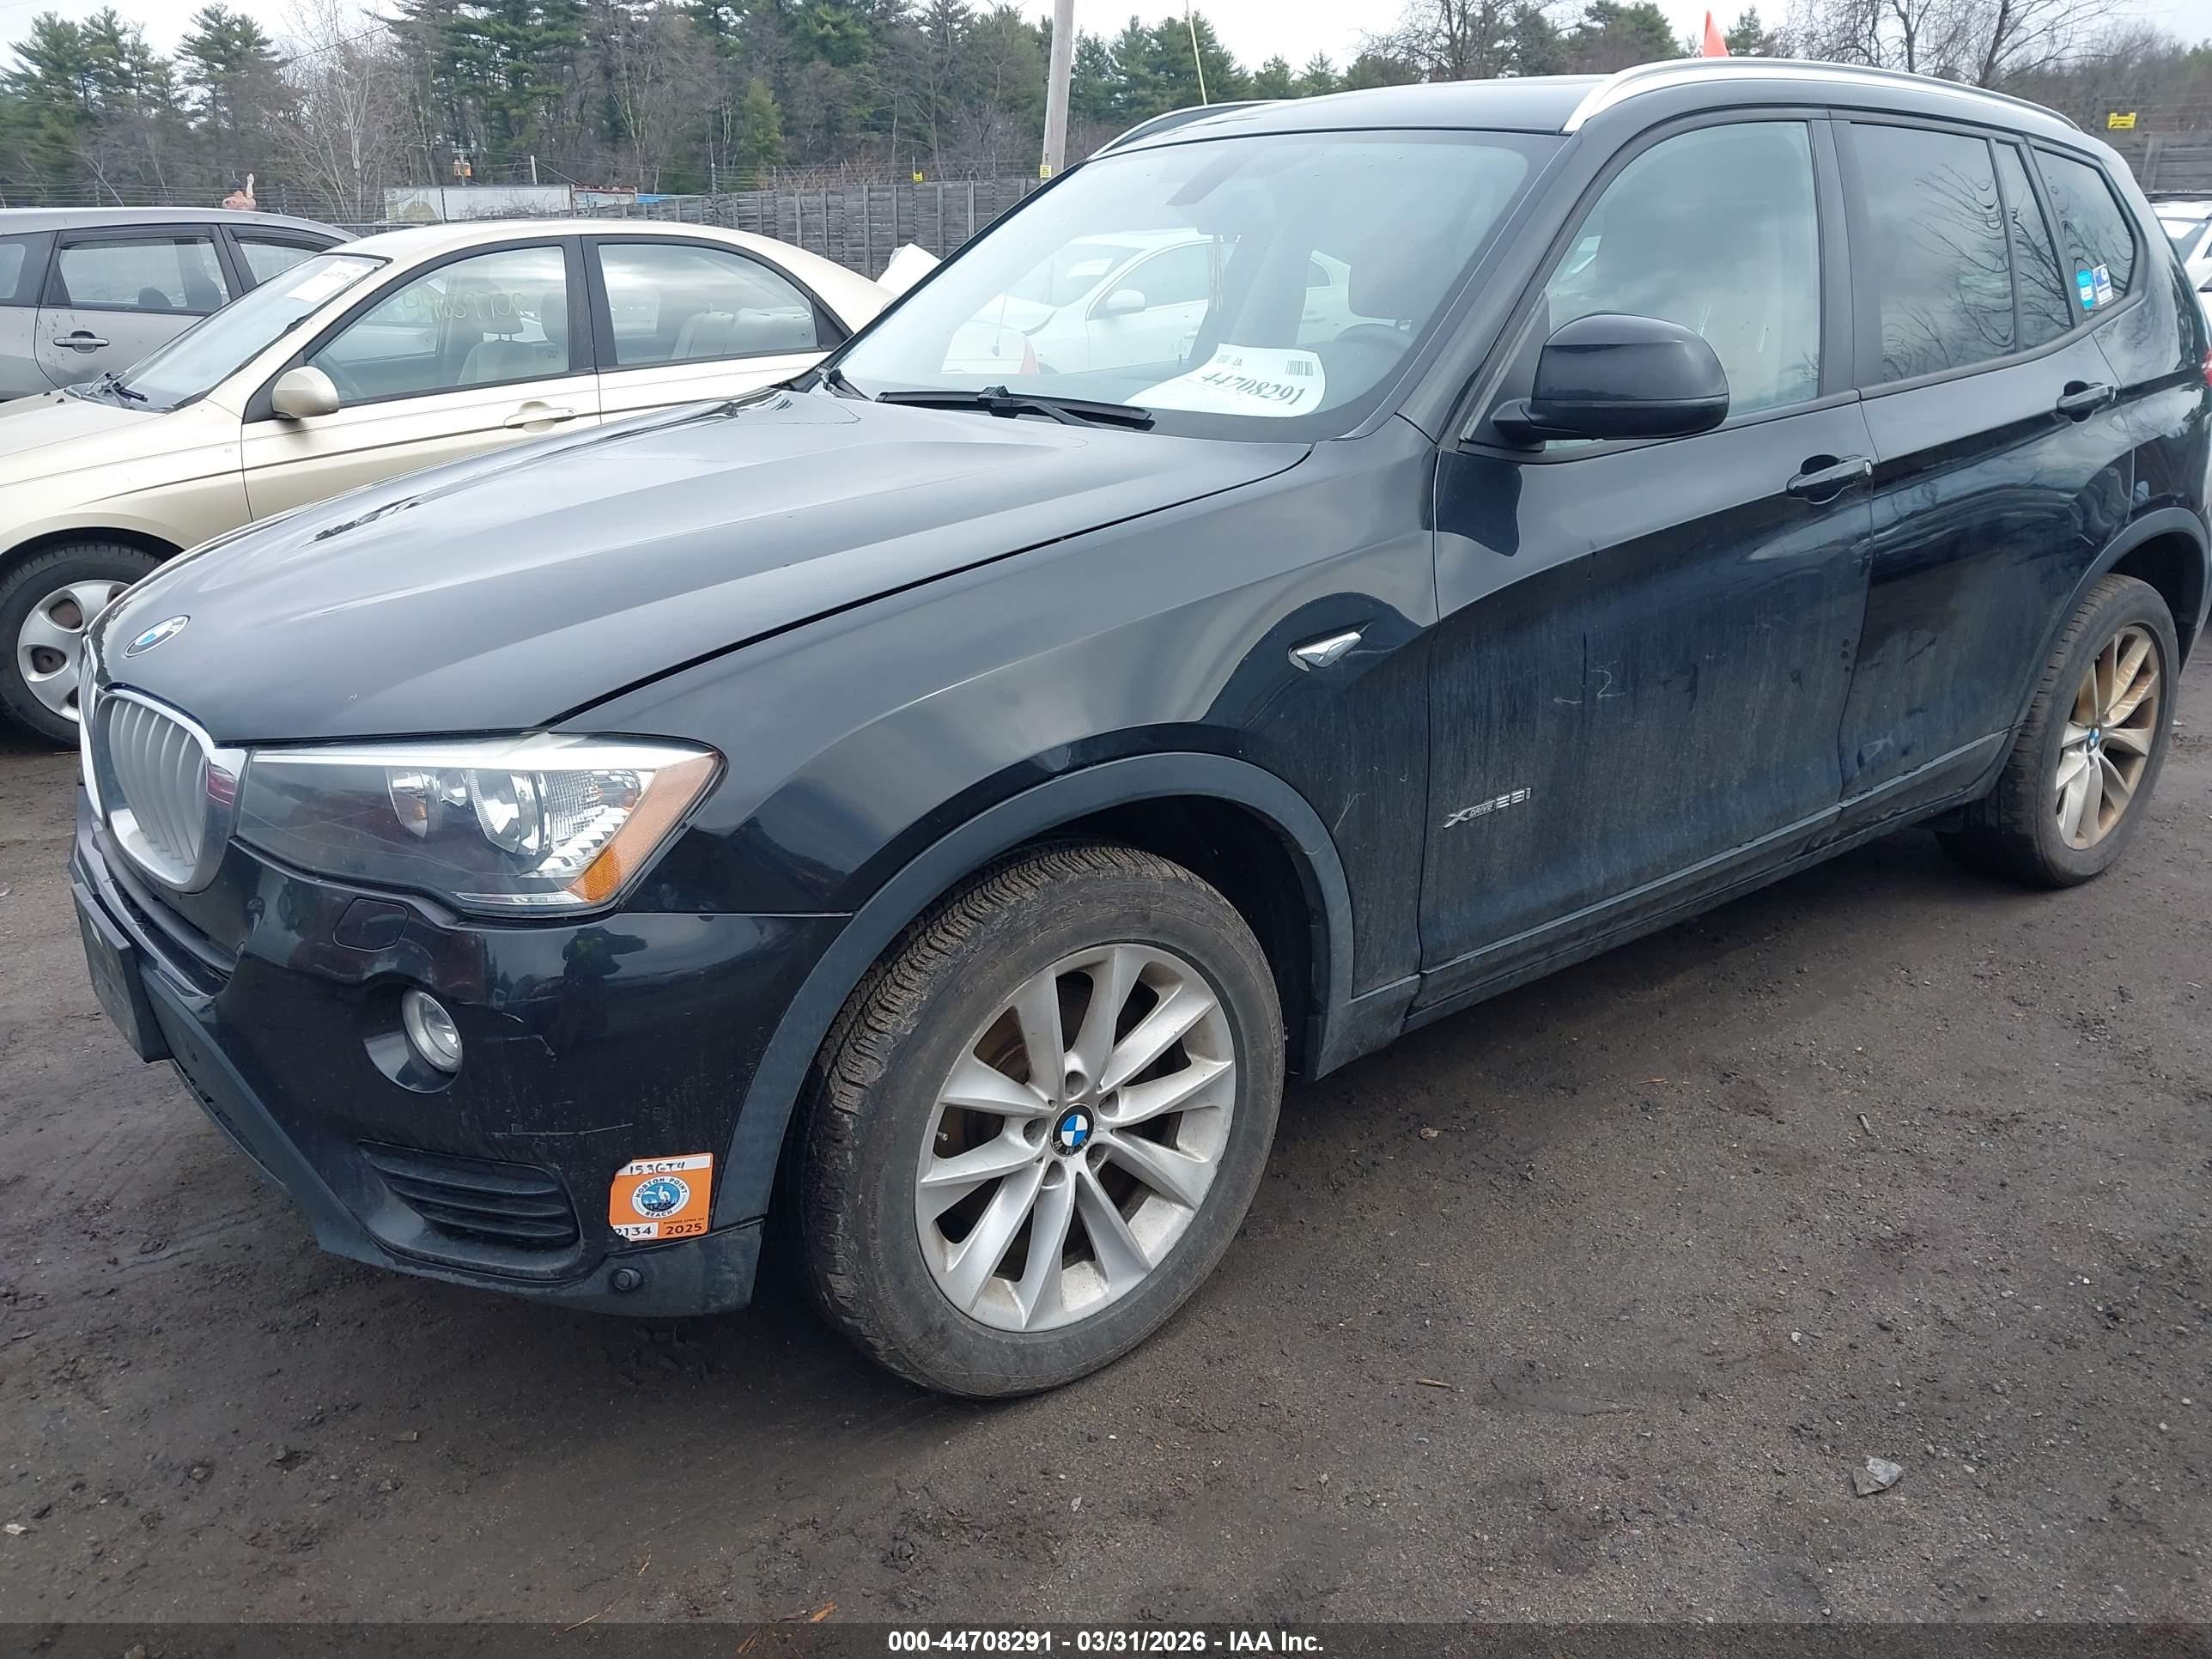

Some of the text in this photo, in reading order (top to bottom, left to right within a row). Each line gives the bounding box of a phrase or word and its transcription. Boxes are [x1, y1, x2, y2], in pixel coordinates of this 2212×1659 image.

[1201, 372, 1305, 405] 44708291
[635, 1177, 688, 1198] NORTON POINT
[645, 1209, 673, 1218] BEACH
[665, 1222, 702, 1235] 2025
